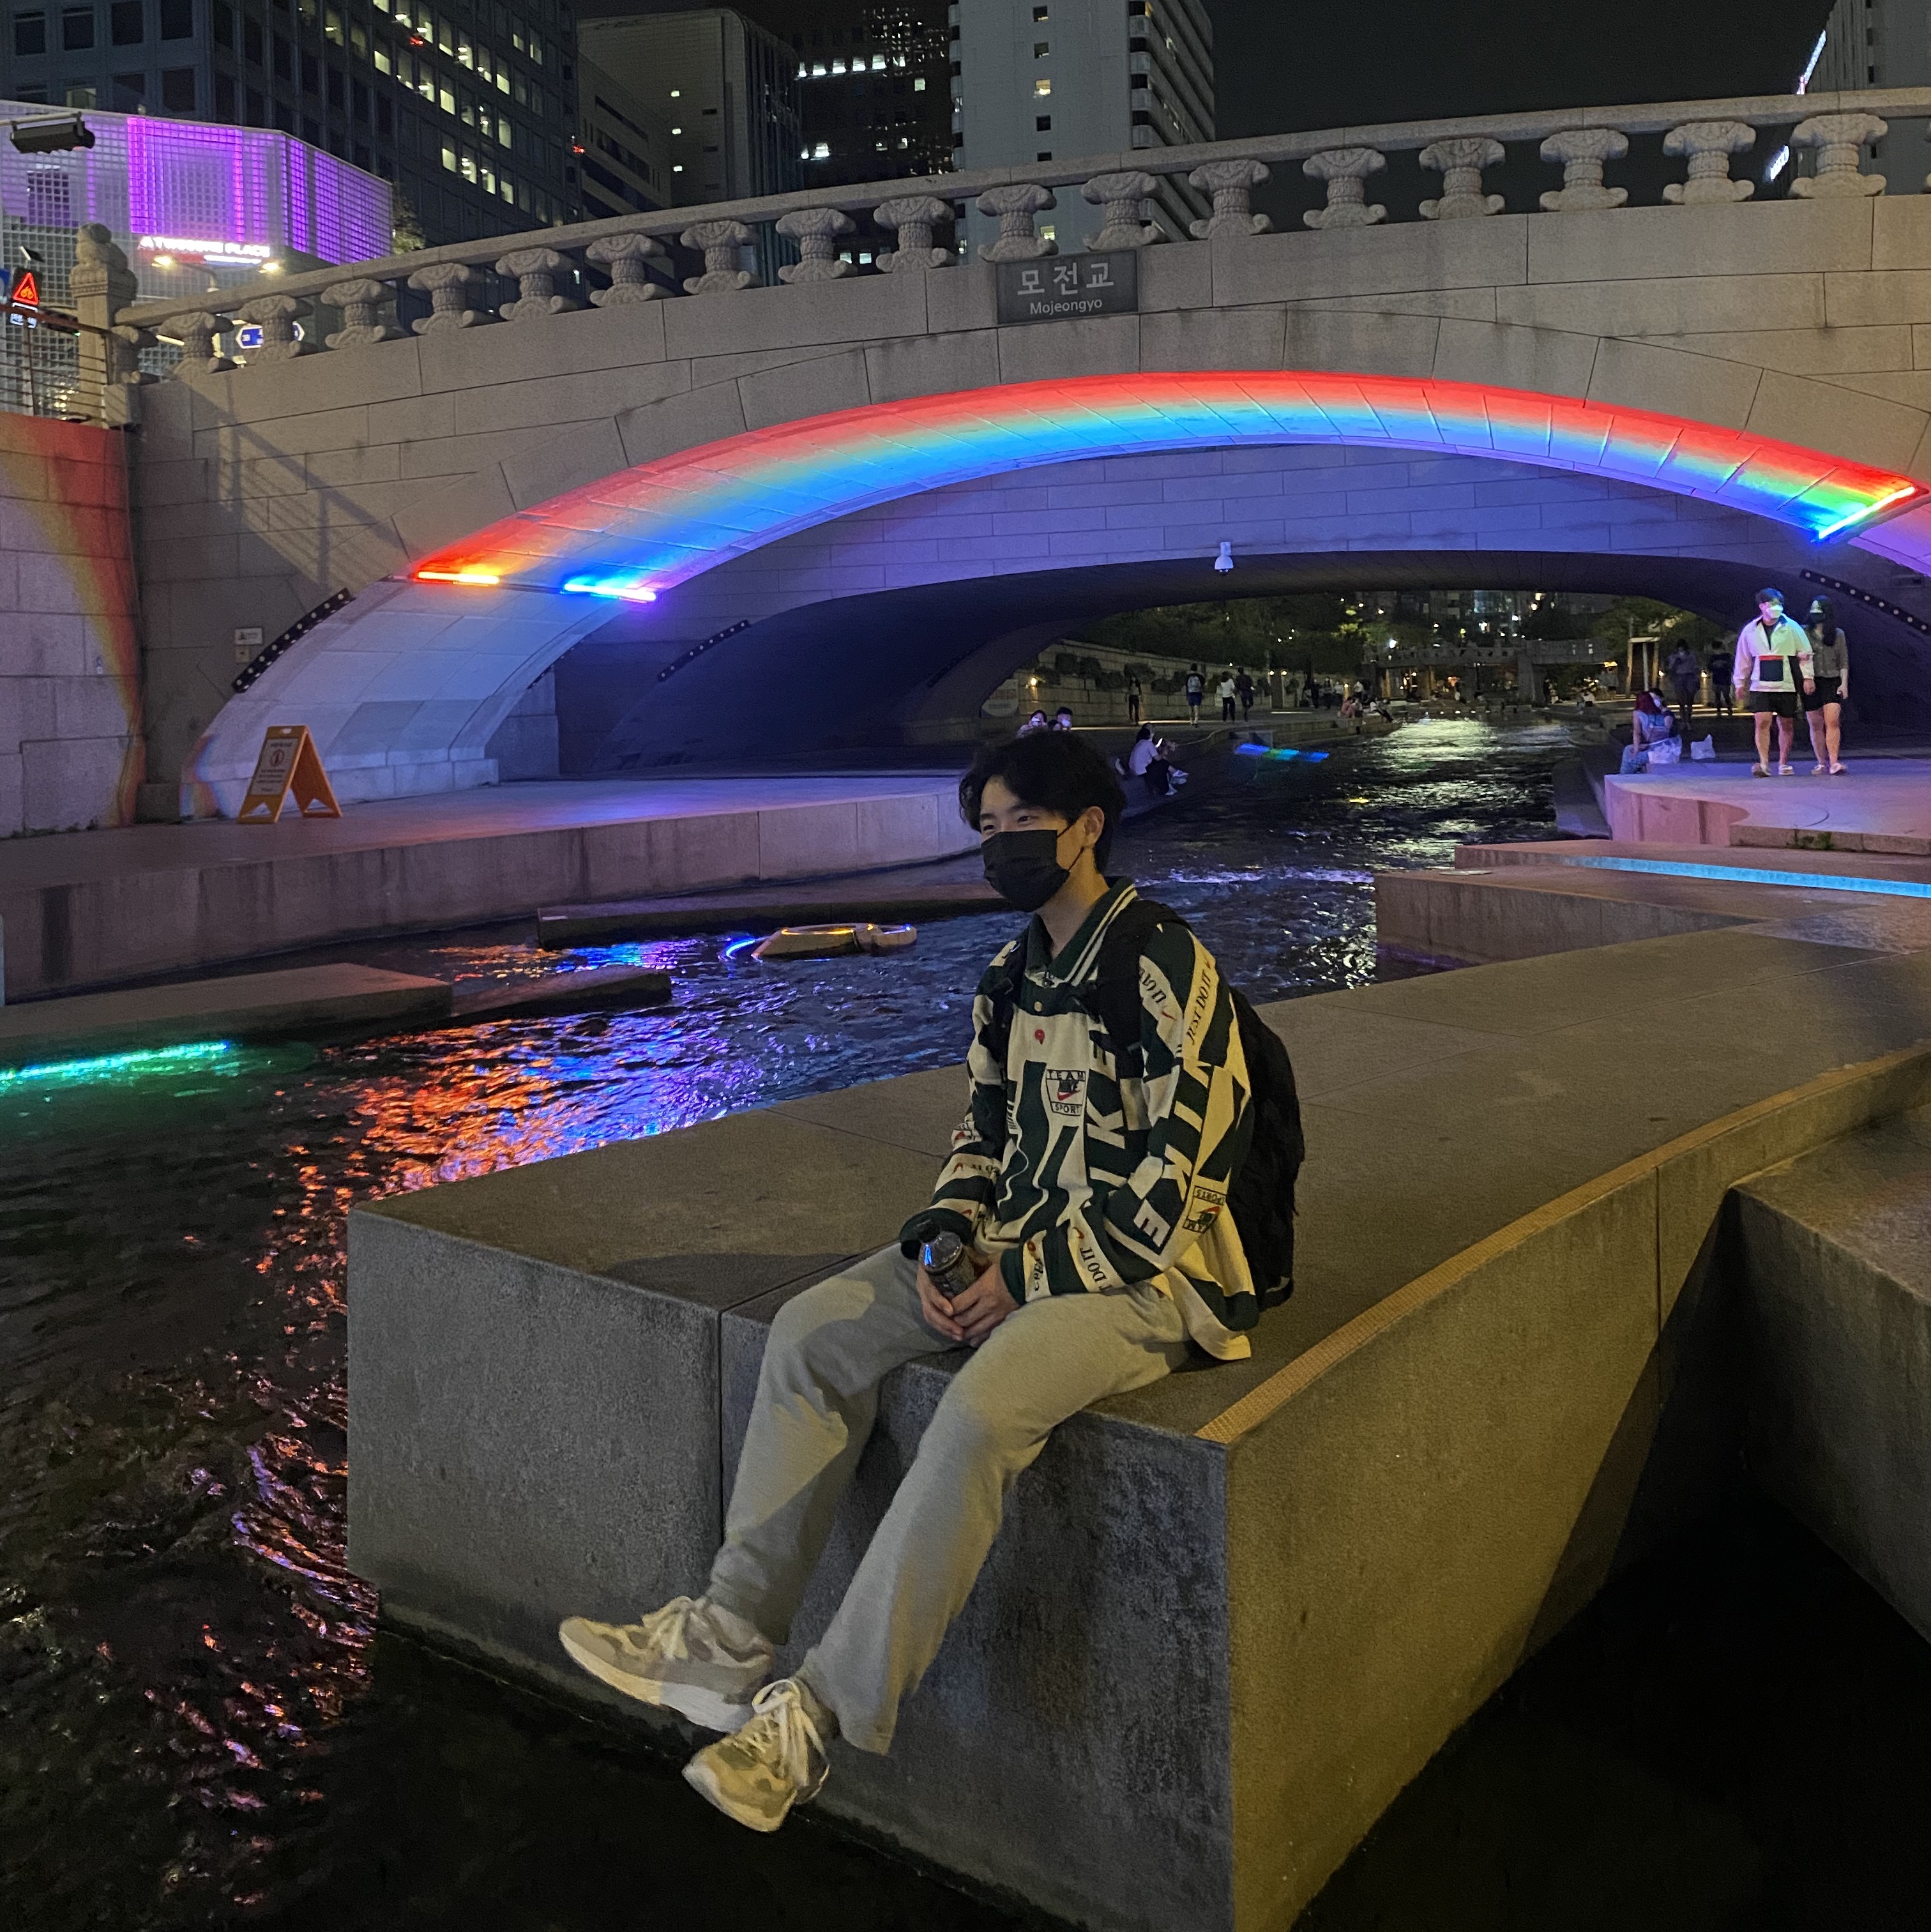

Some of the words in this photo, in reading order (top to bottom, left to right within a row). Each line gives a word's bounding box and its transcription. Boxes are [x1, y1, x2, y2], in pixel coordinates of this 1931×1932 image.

[1030, 299, 1102, 315] Mojeongyo
[1201, 970, 1211, 988] IT
[1196, 987, 1209, 1010] DO
[1186, 1007, 1201, 1045] JUST
[1048, 1070, 1084, 1081] TEAM
[1079, 1247, 1095, 1262] IT
[1087, 1263, 1107, 1282] DO
